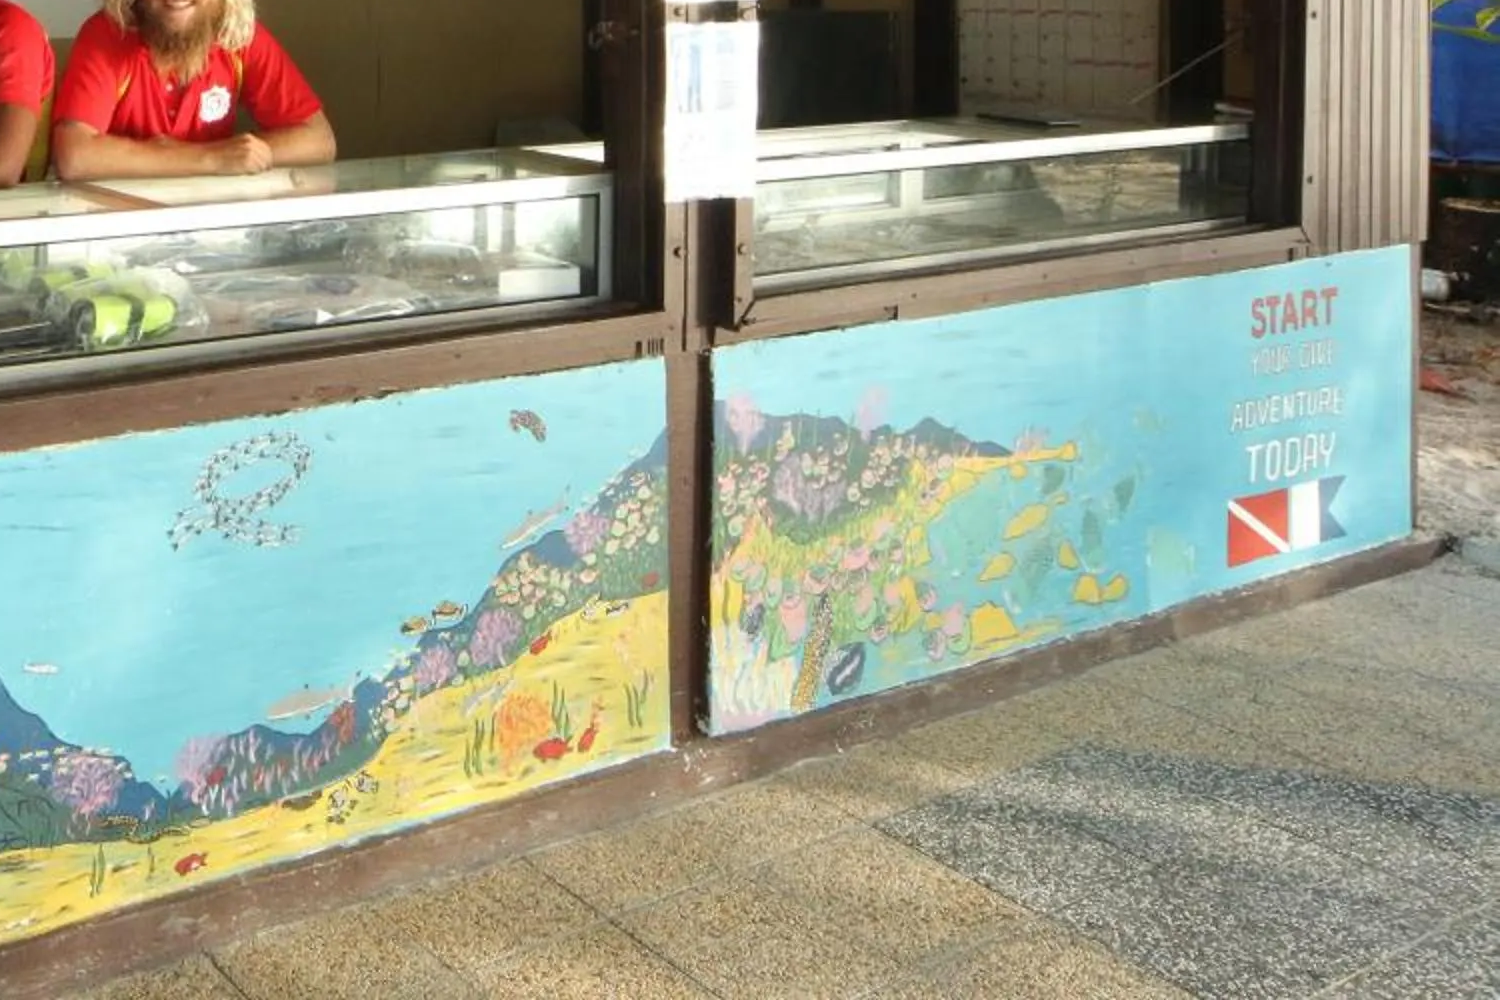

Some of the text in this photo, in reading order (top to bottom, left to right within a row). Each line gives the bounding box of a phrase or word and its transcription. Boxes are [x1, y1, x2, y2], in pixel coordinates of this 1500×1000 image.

[1251, 287, 1338, 339] START
[1230, 385, 1344, 433] ADVENTURE
[1246, 432, 1336, 483] TODAY
